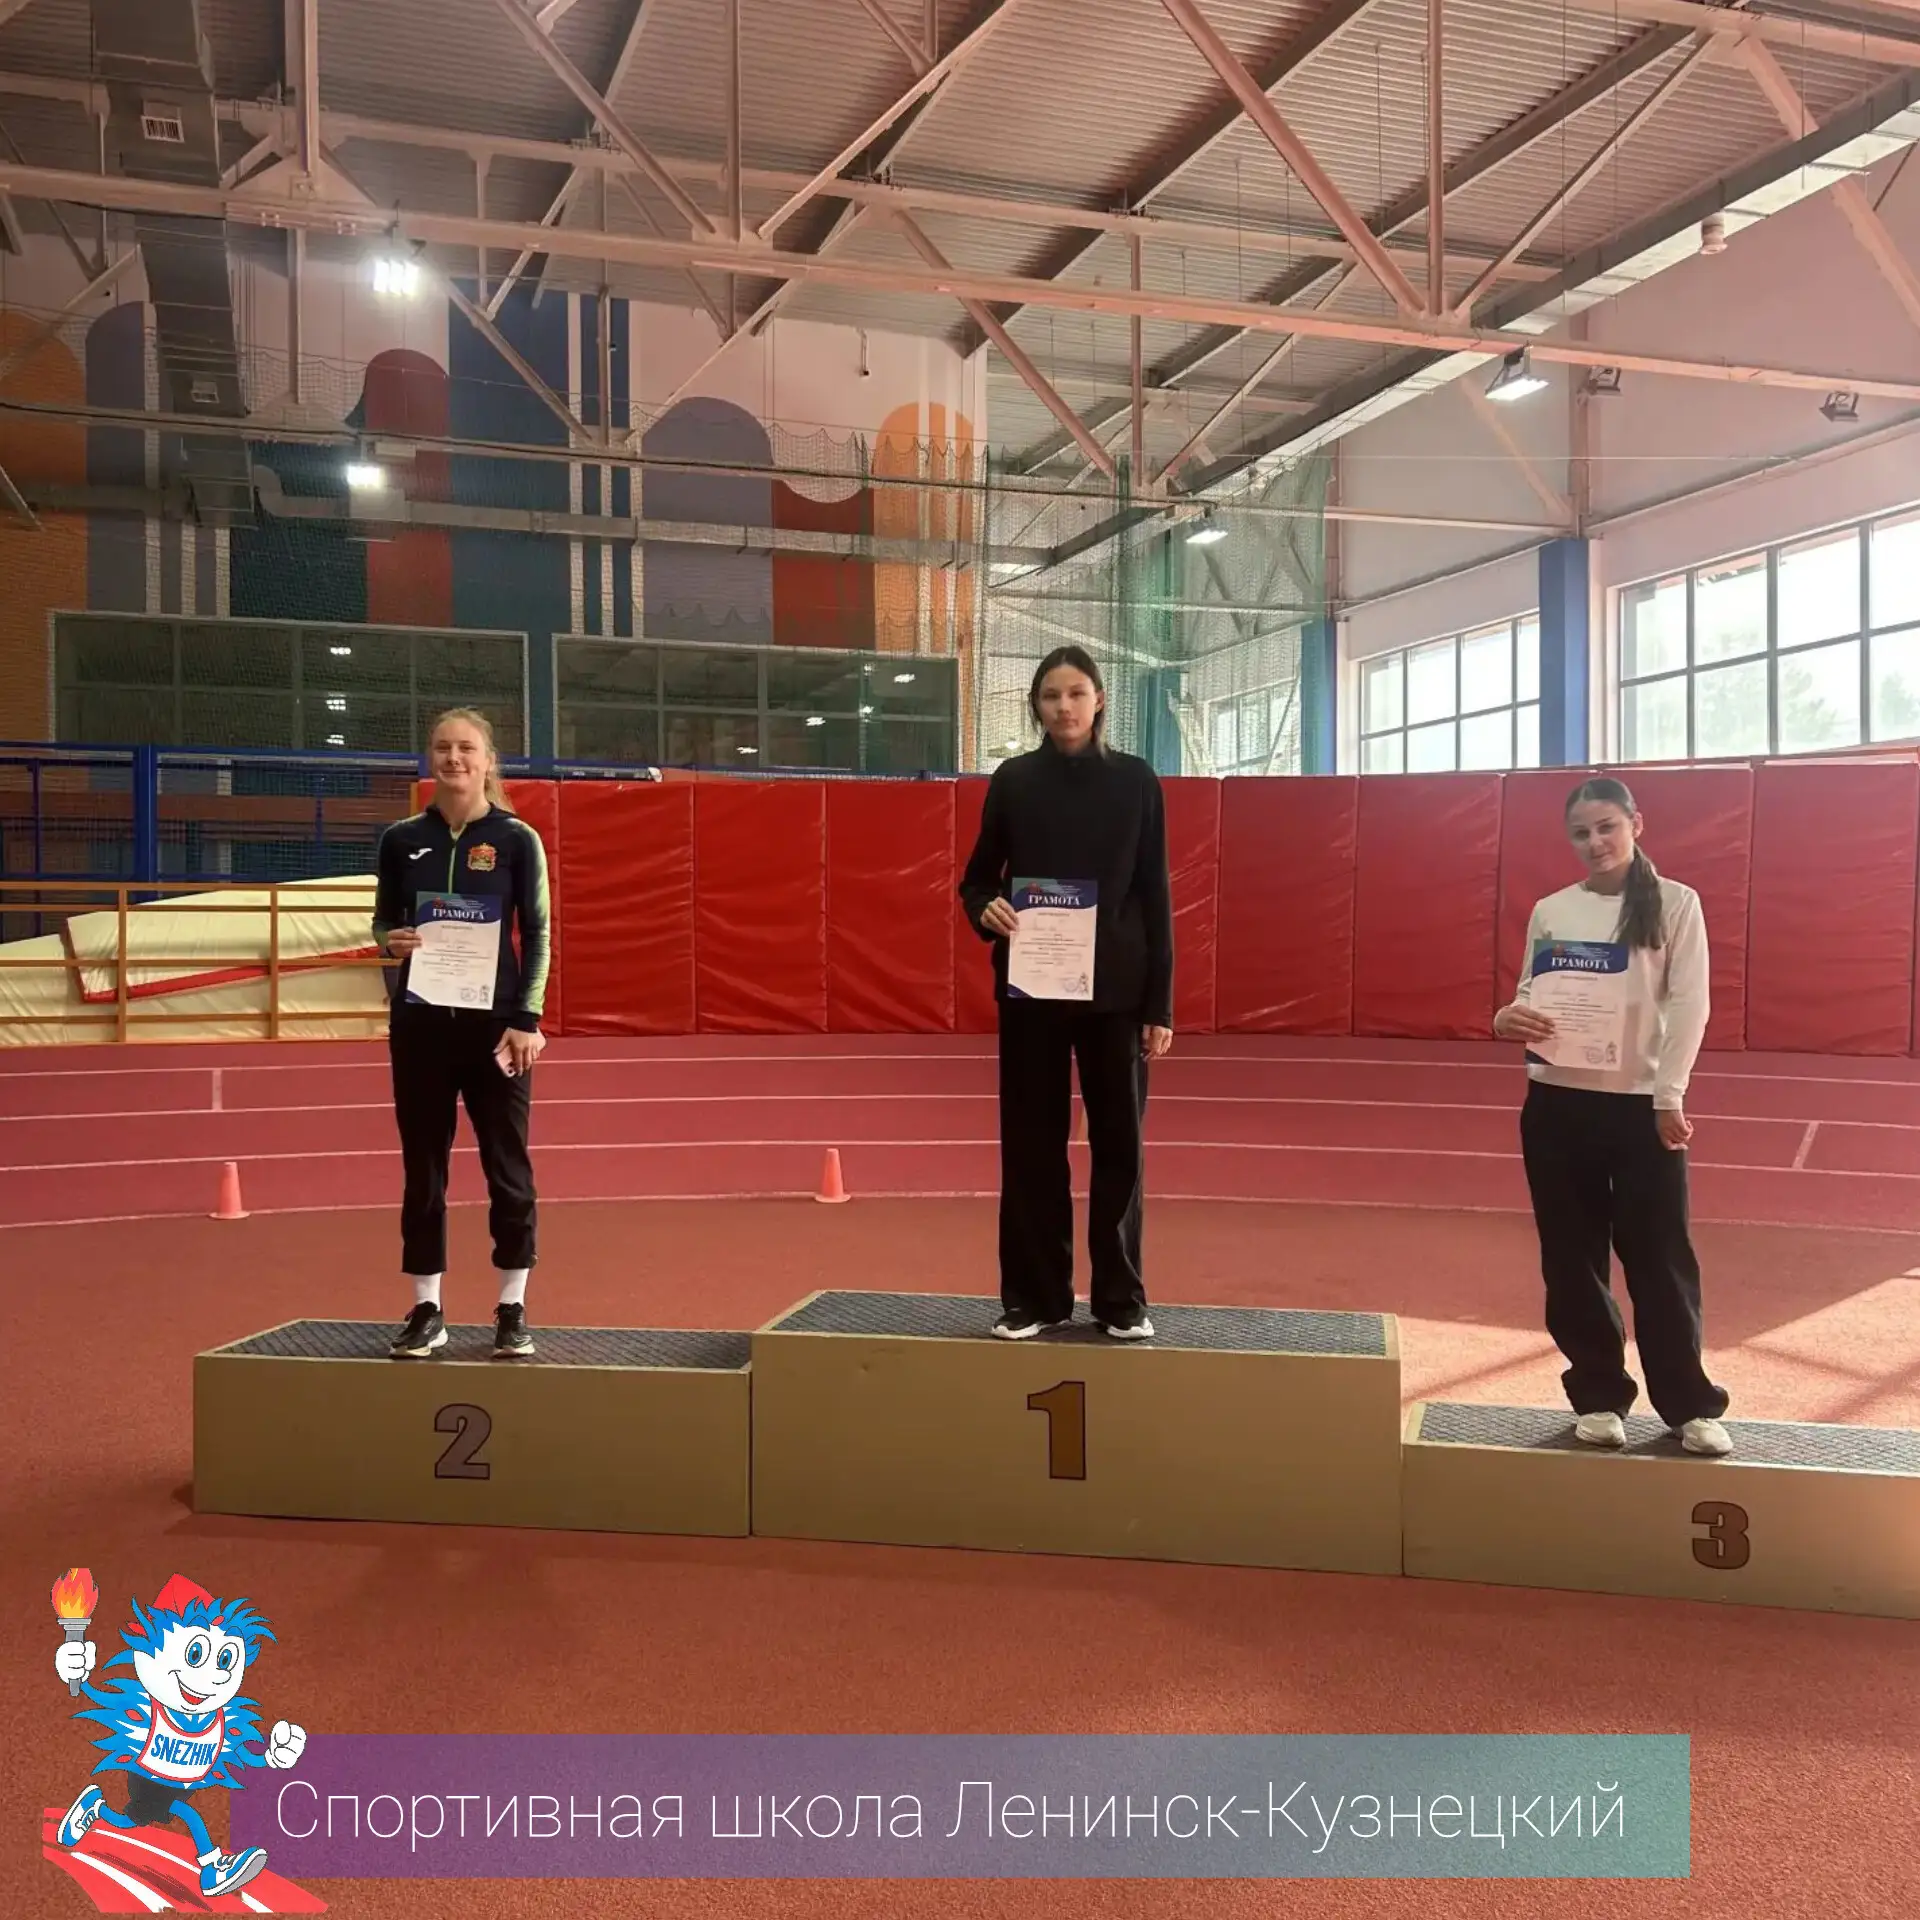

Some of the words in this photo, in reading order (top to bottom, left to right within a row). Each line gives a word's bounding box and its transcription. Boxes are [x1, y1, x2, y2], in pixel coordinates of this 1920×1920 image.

[432, 908, 485, 920] ГРАМОТА
[1028, 894, 1081, 906] ГРАМОТА
[1551, 956, 1609, 970] ГРАМОТА
[434, 1403, 492, 1480] 2
[1027, 1381, 1086, 1480] 1
[1692, 1501, 1750, 1569] 3
